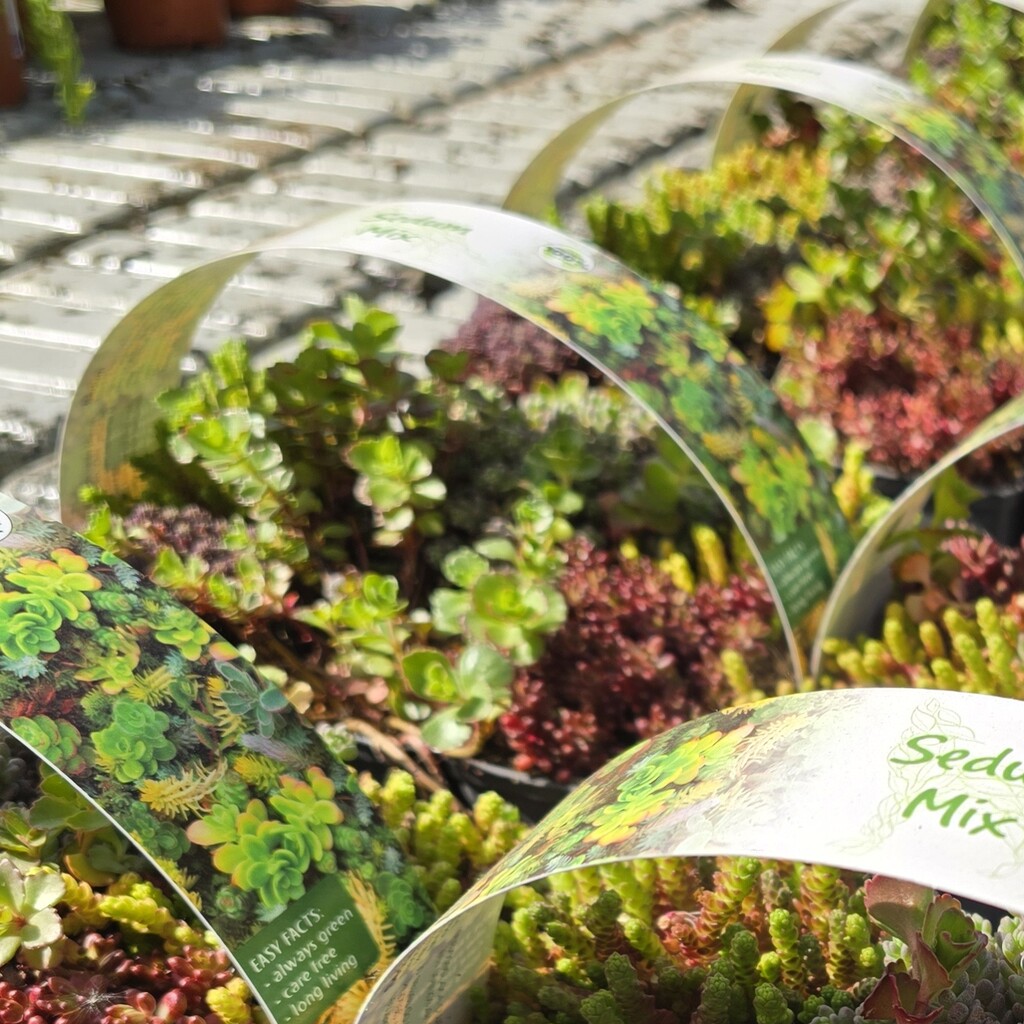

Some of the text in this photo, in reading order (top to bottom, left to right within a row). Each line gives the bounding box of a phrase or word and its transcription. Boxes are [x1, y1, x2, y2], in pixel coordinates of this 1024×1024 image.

[902, 788, 1017, 838] Mix
[249, 907, 325, 973] EASY FACTS:
[273, 939, 318, 983] always
[318, 908, 354, 945] green
[281, 970, 312, 999] care
[310, 947, 338, 973] free
[289, 985, 324, 1016] long
[320, 954, 358, 988] living
